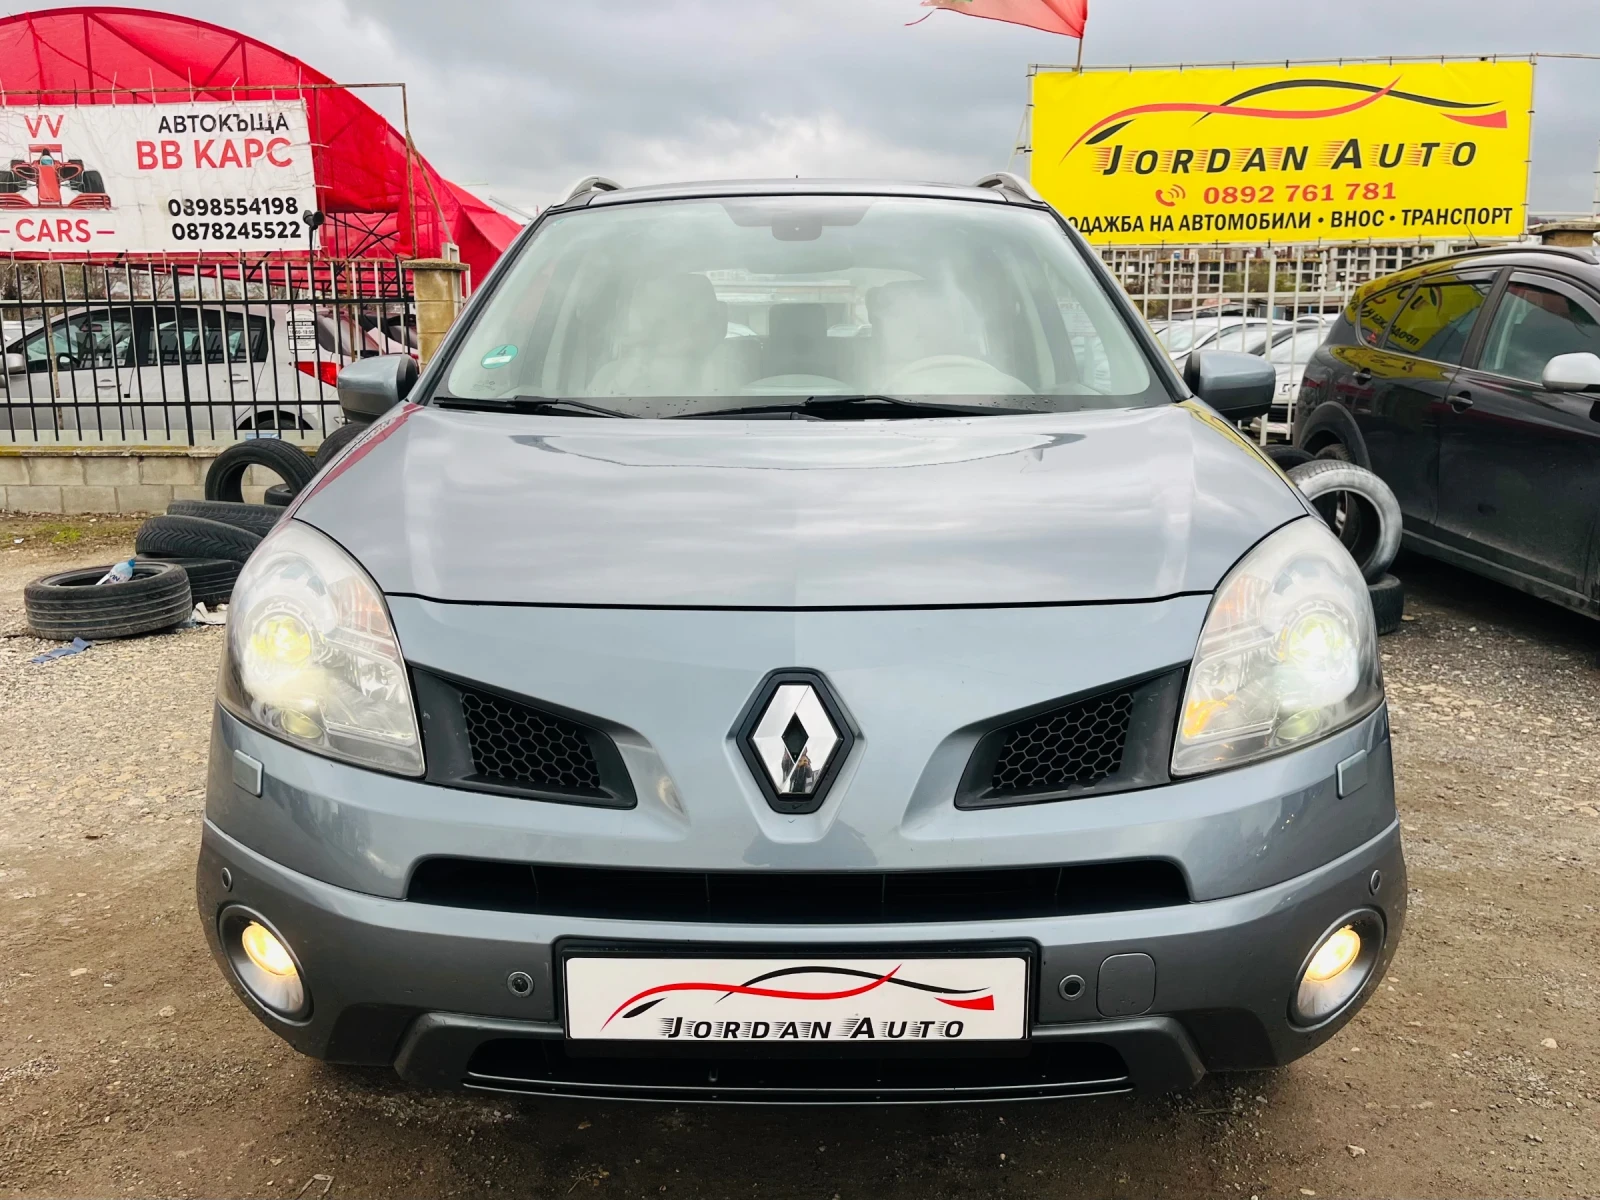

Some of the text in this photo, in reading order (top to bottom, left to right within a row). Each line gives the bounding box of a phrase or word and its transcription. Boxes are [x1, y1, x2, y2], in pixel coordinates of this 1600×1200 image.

[24, 115, 64, 138] VV
[158, 112, 290, 134] АВТОКЪЩА
[194, 137, 293, 169] КАРС
[1203, 182, 1397, 205] 0892 761 781
[168, 197, 299, 217] 0898554198
[171, 220, 302, 241] 0878245522
[1067, 207, 1513, 237] ОДАЖБА НА АВТОМОБИЛИ ВНОС ТРАНСПОРТ
